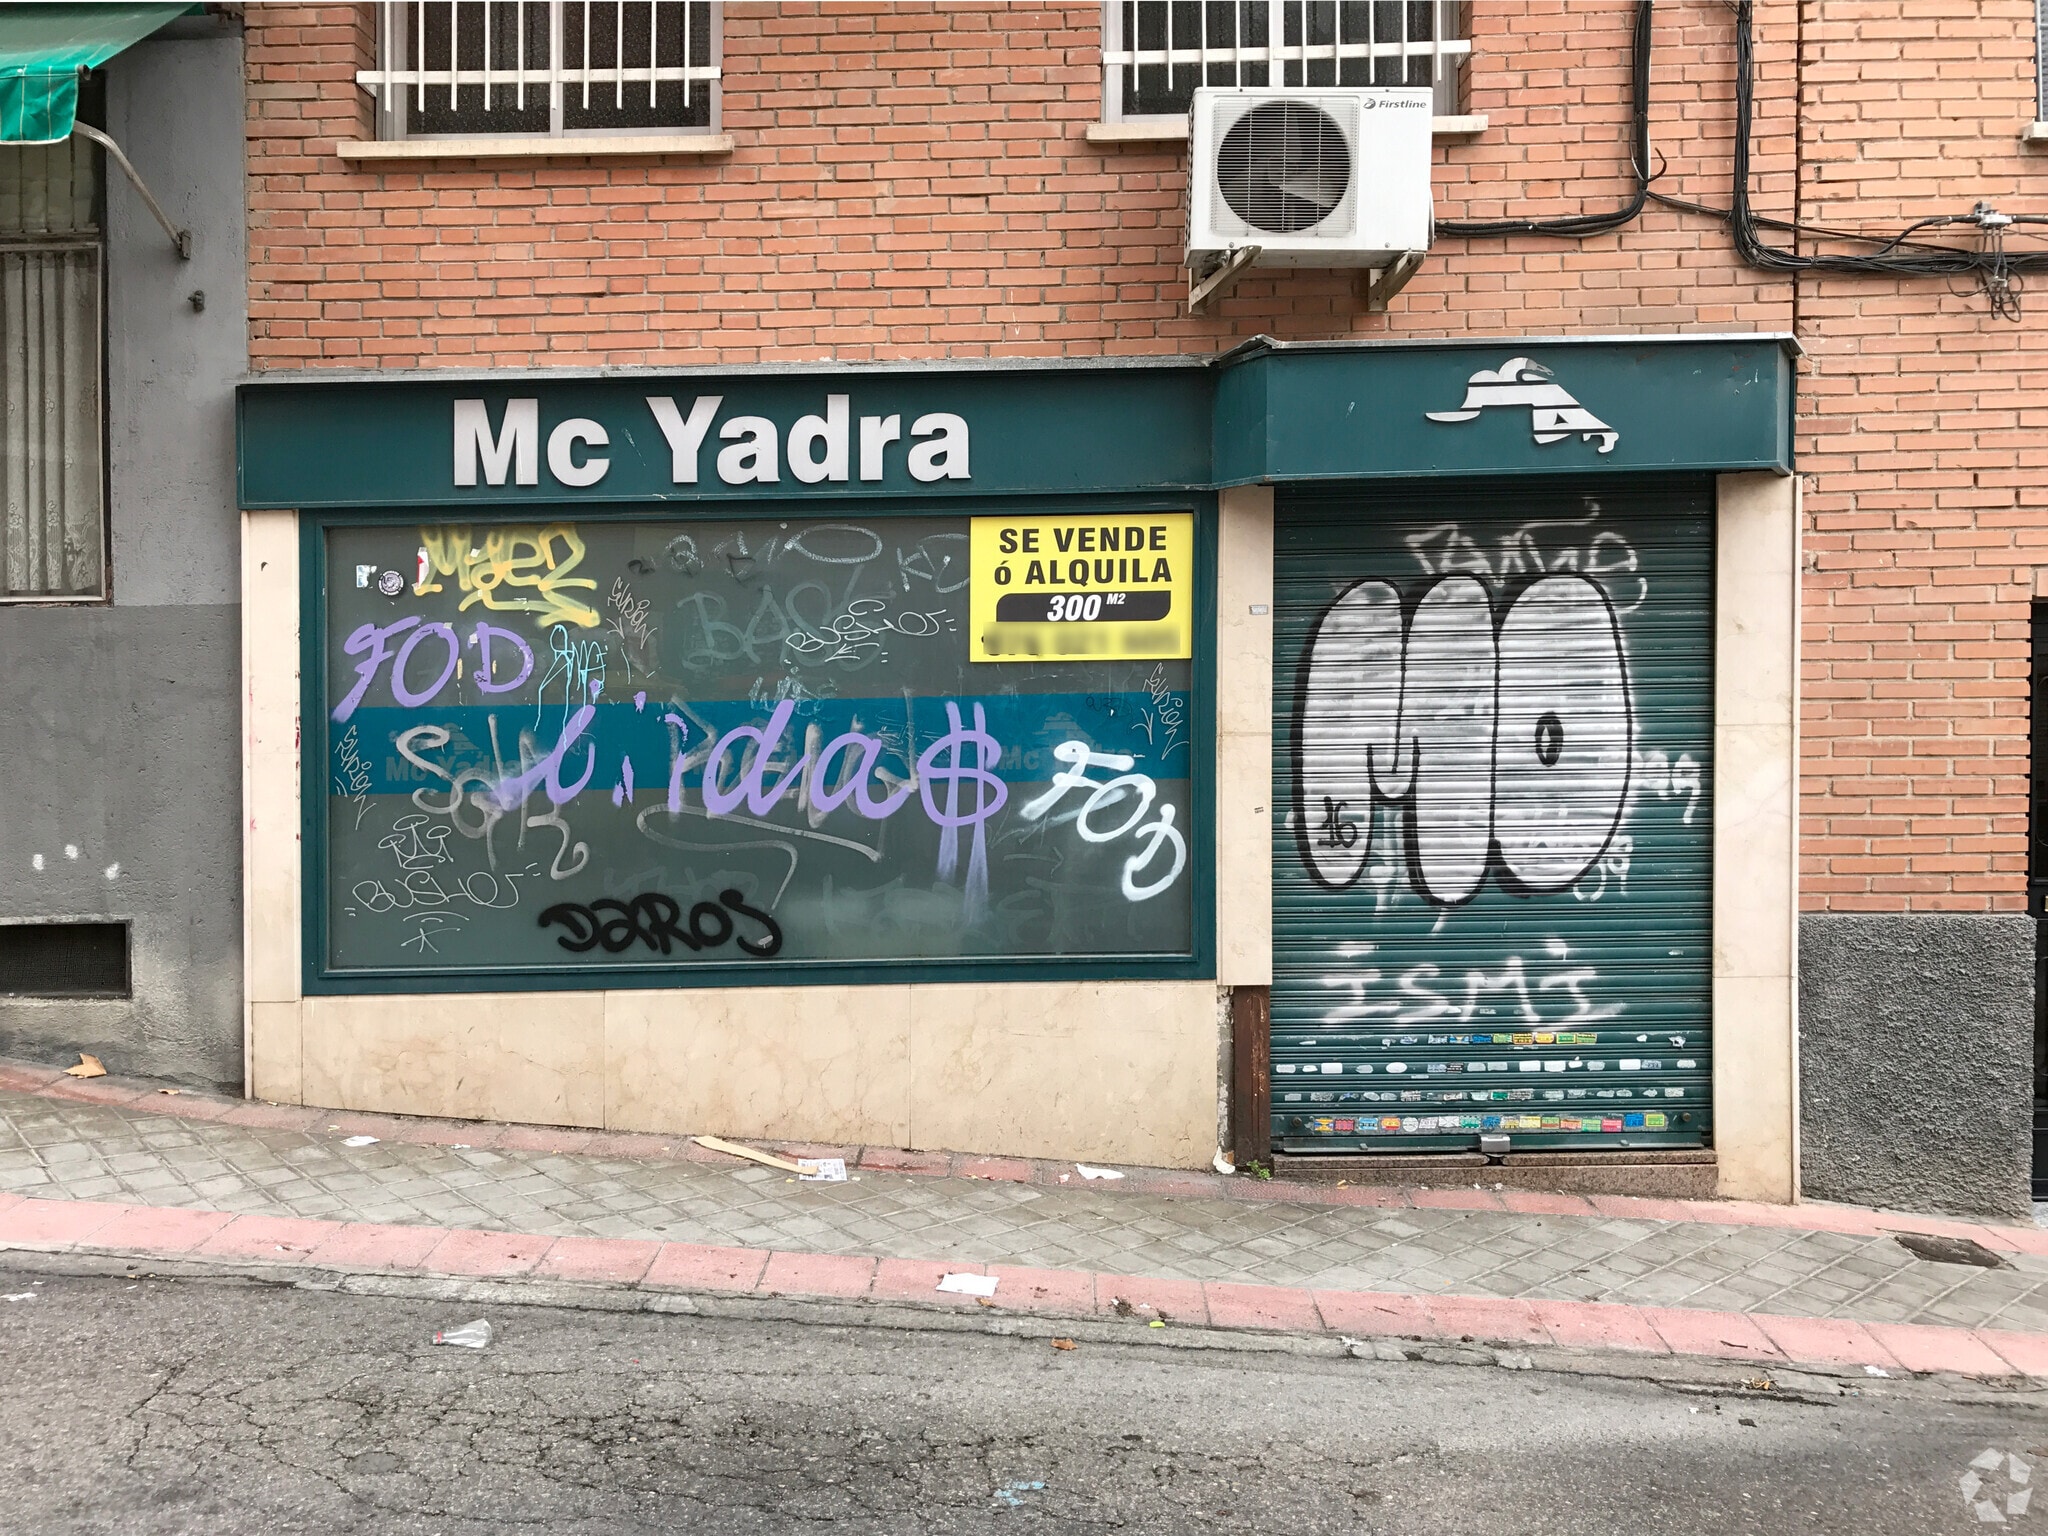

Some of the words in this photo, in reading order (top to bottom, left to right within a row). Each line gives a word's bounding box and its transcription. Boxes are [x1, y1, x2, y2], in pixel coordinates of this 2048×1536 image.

[1379, 100, 1427, 108] Firstline
[453, 398, 610, 487] Mc
[645, 394, 972, 484] Yadra
[999, 528, 1040, 553] SE
[1053, 526, 1167, 552] VENDE
[1025, 558, 1172, 586] ALQUILA
[1047, 594, 1101, 621] 300
